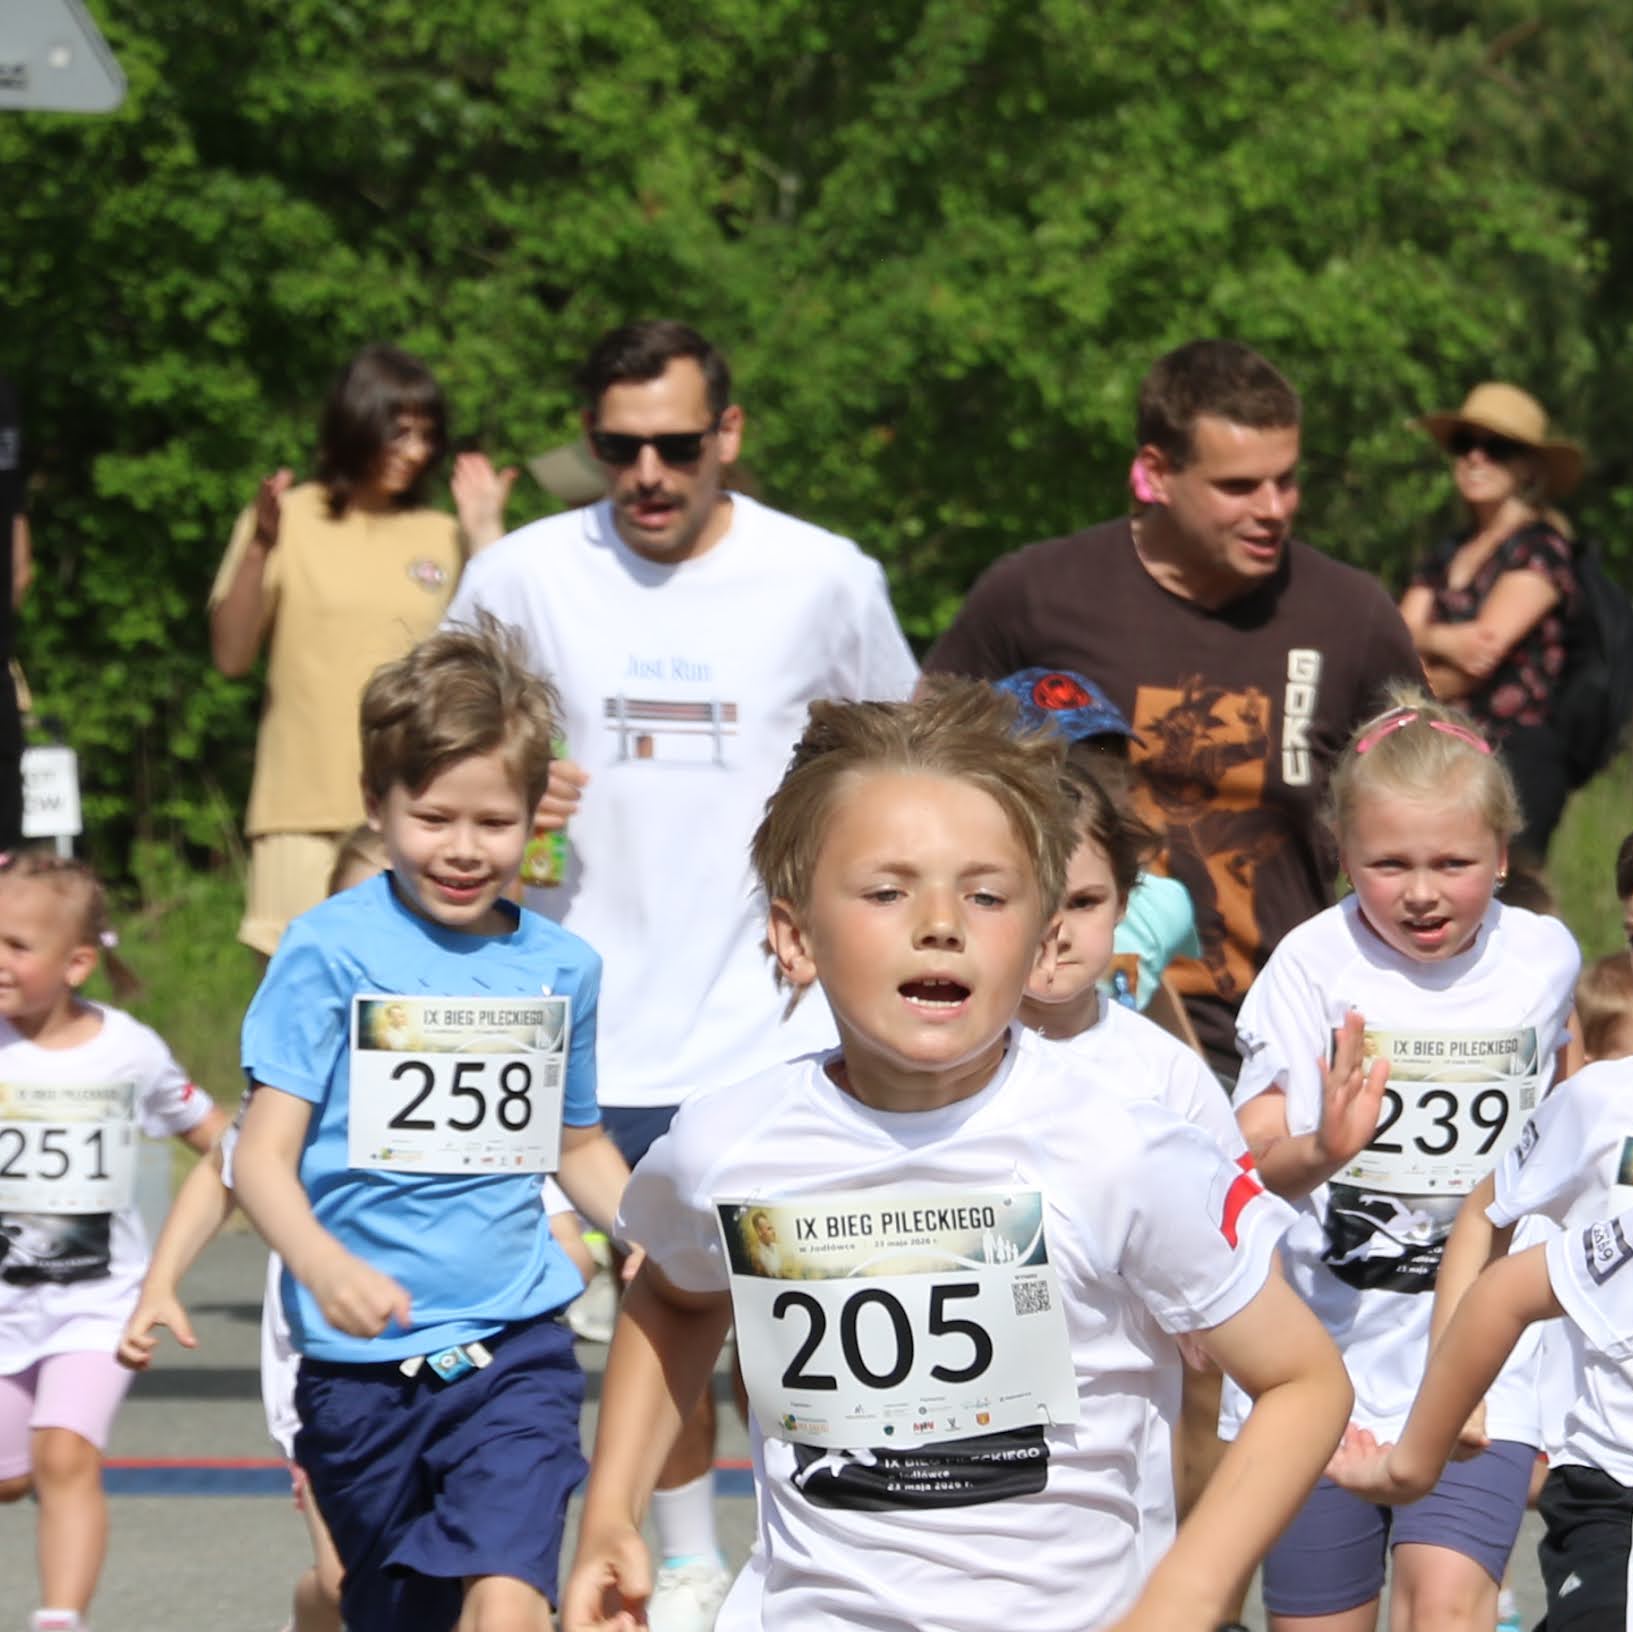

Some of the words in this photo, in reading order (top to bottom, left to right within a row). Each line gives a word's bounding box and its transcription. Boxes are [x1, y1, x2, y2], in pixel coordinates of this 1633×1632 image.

[625, 654, 664, 680] Just
[671, 656, 713, 682] Run
[1281, 648, 1322, 786] GOKU
[423, 1010, 440, 1025] IX
[444, 1010, 475, 1026] BIEG
[479, 1010, 544, 1026] PILECKIEGO
[1393, 1040, 1409, 1055] IX
[1414, 1040, 1444, 1056] BIEG
[1450, 1038, 1518, 1056] PILECKIEGO
[387, 1060, 532, 1132] 258
[1362, 1088, 1509, 1156] 239
[0, 1128, 110, 1180] 251
[795, 1217, 818, 1240] IX
[826, 1212, 873, 1238] BIEG
[881, 1205, 995, 1234] PILECKIEGO
[772, 1282, 993, 1391] 205
